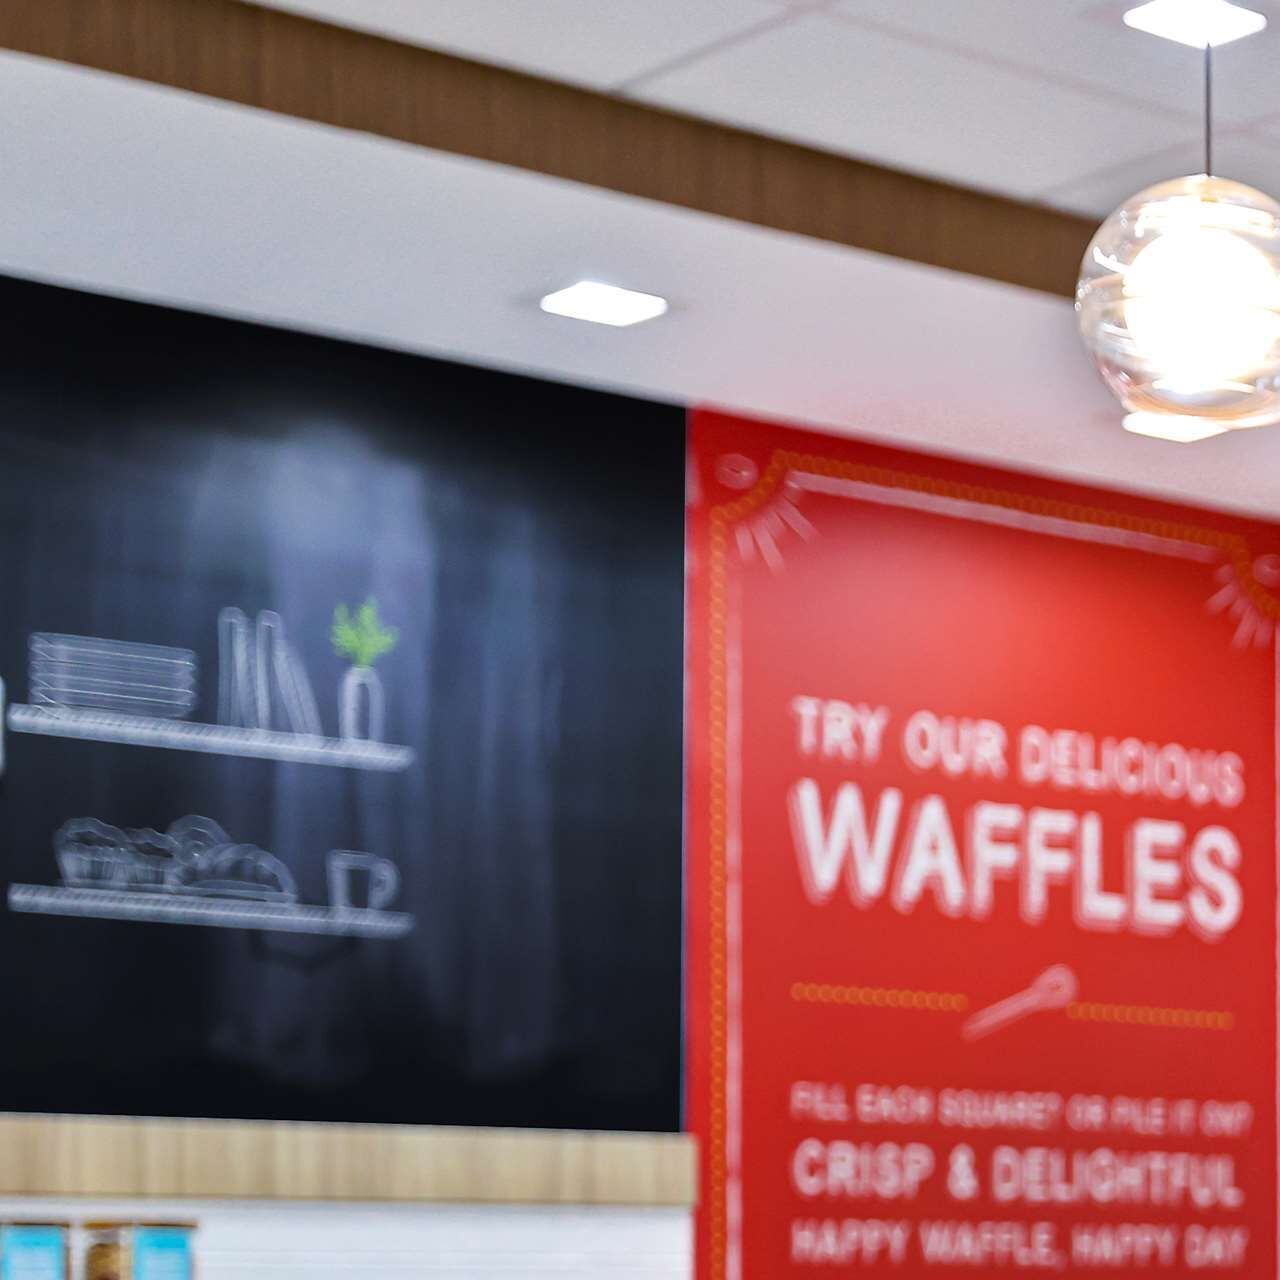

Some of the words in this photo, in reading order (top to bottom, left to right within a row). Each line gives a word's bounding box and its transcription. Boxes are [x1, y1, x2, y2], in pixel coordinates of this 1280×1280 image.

[791, 695, 890, 761] TRY
[904, 708, 1008, 778] OUR
[1018, 725, 1247, 808] DELICIOUS
[789, 778, 1243, 940] WAFFLES
[791, 1137, 935, 1200] CRISP
[947, 1142, 980, 1202] &
[791, 1218, 911, 1264] HAPPY
[1071, 1222, 1179, 1267] HAPPY
